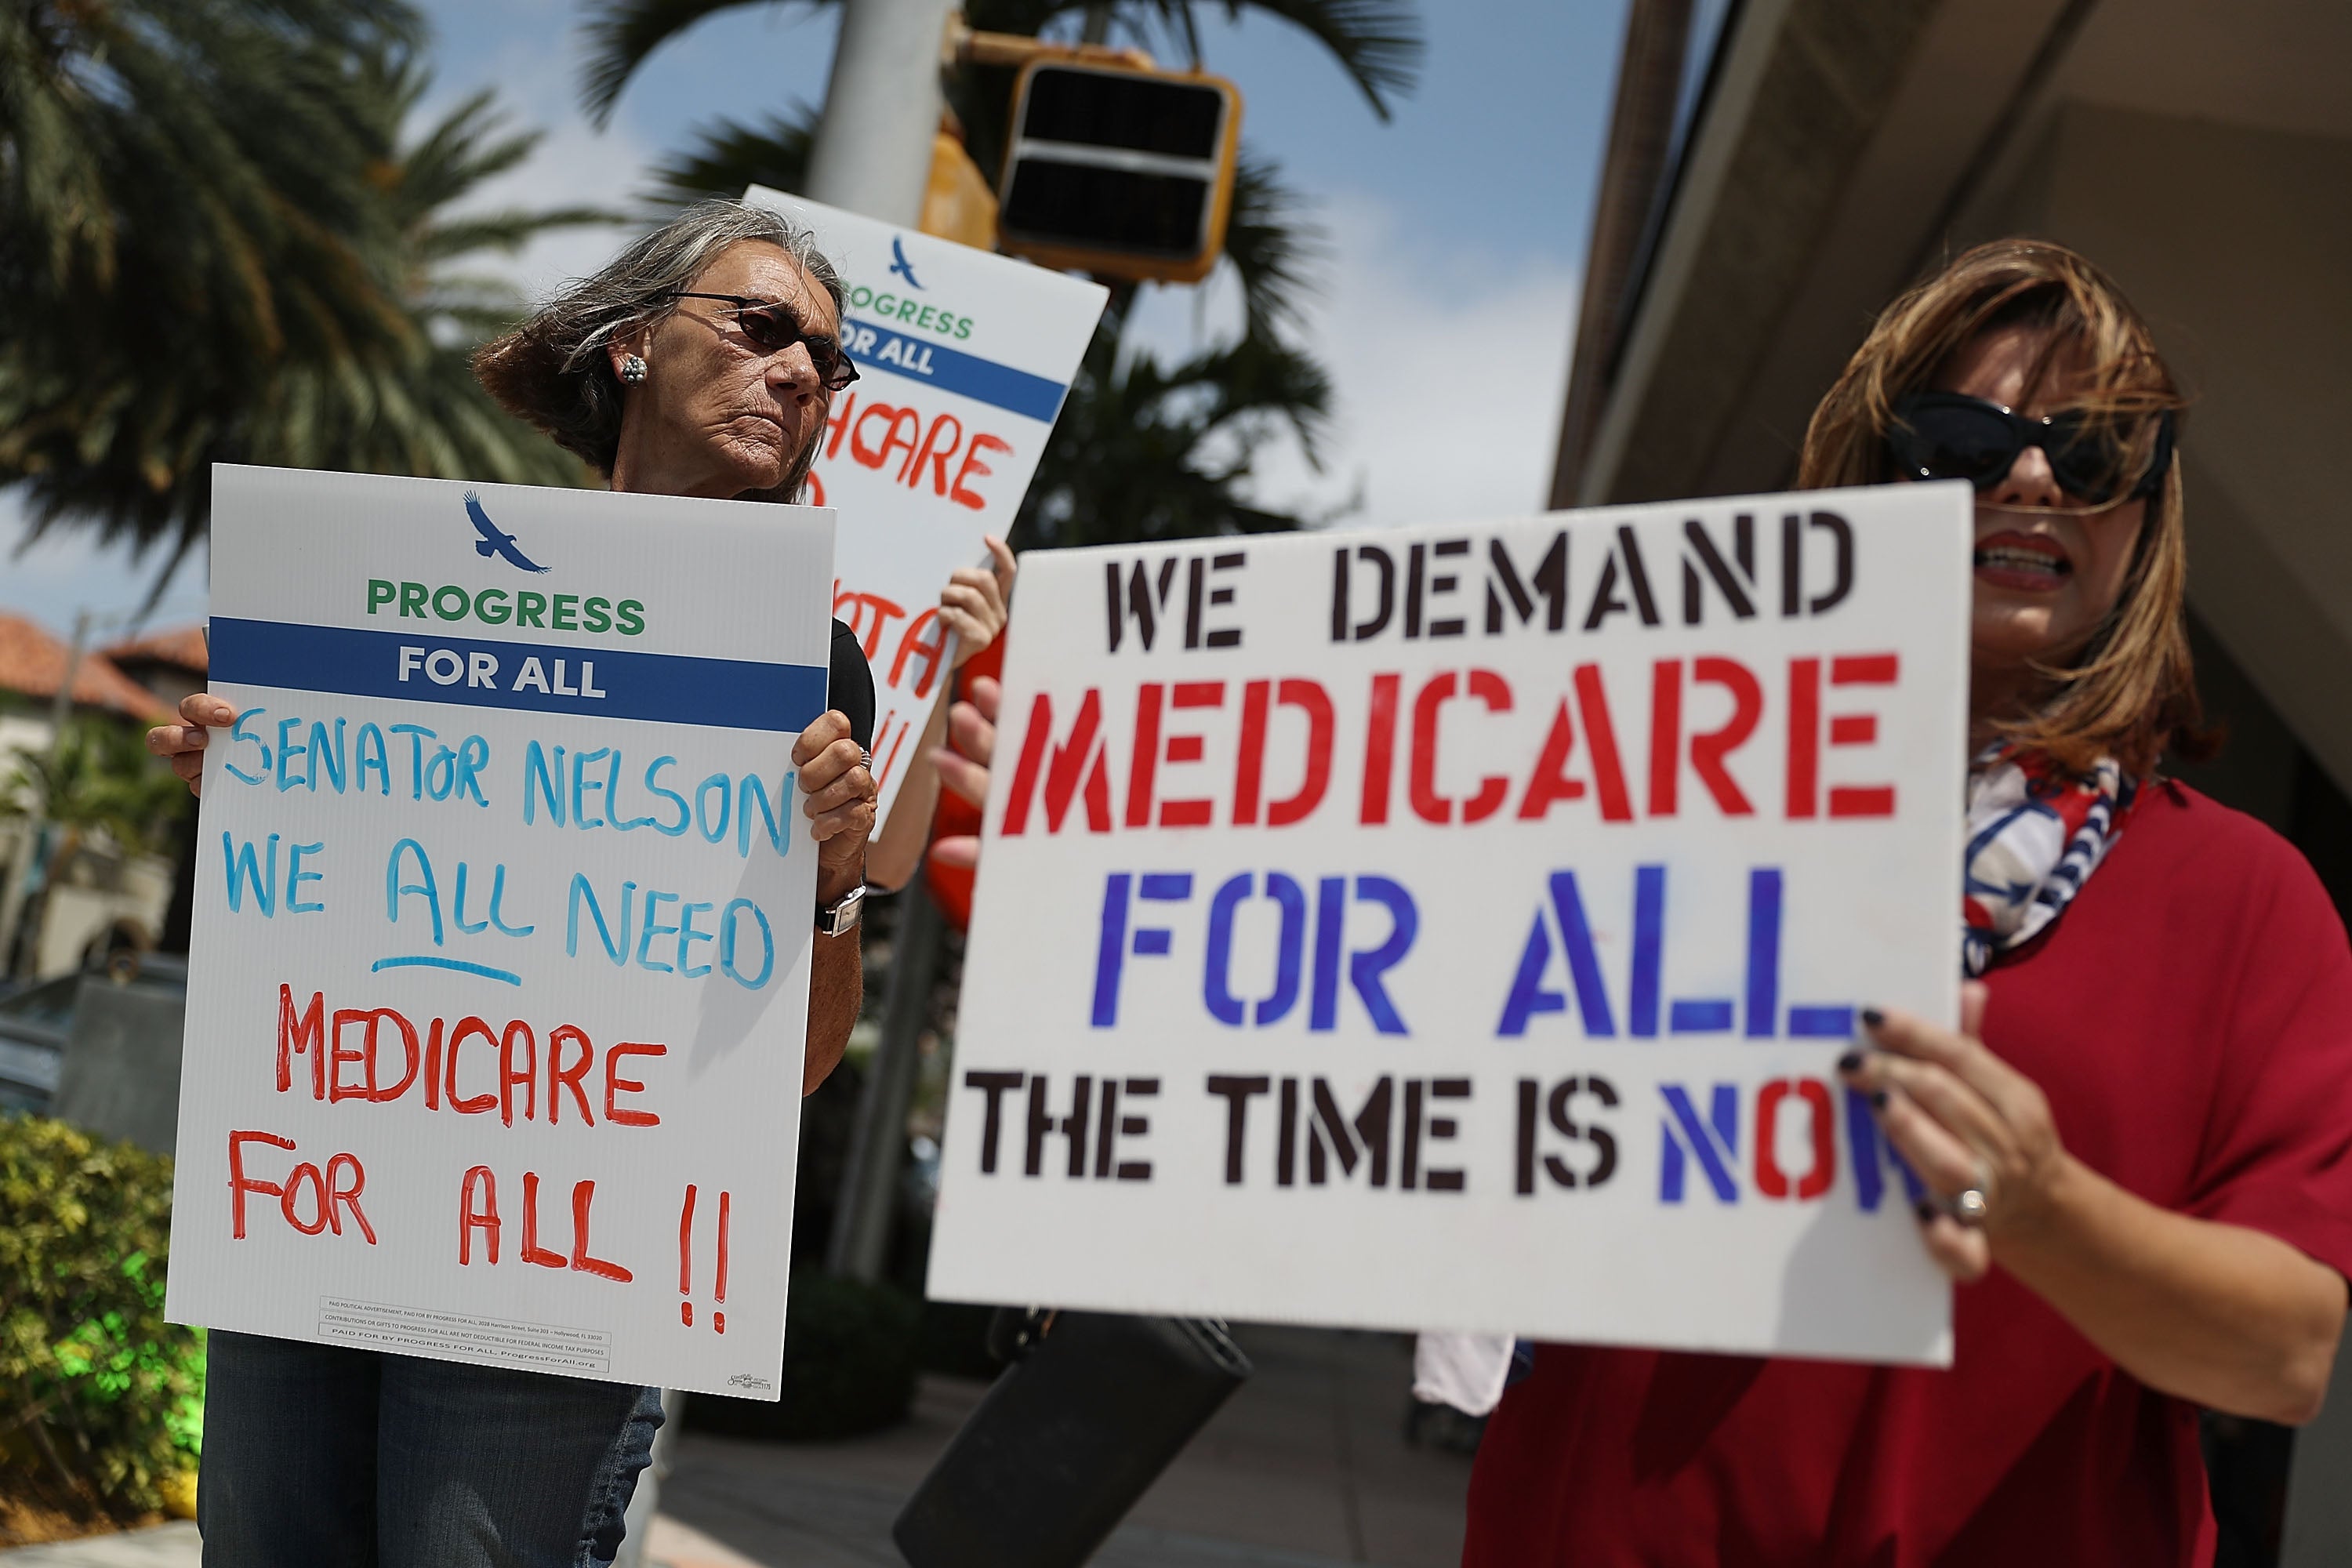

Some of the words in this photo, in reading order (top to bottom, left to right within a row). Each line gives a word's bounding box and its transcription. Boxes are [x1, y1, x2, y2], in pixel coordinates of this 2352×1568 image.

[839, 280, 975, 340] OGRESS
[840, 321, 879, 356] OR
[877, 336, 935, 376] ALL
[368, 579, 645, 636] PROGRESS
[1105, 553, 1246, 653] WE
[1330, 510, 1856, 643] DEMAND
[398, 646, 496, 689] FOR
[512, 657, 606, 699] ALL
[224, 707, 489, 808] SENATOR
[524, 739, 795, 858] NELSON
[1000, 654, 1900, 837] MEDICARE
[223, 831, 325, 918] WE
[387, 838, 535, 946] ALL
[566, 873, 775, 990] NEED
[1091, 872, 1420, 1036] FOR
[1496, 864, 1857, 1040] ALL
[276, 983, 668, 1128] MEDICARE
[964, 1070, 1161, 1181] THE
[1206, 1074, 1473, 1192] TIME
[1515, 1075, 1621, 1197] IS
[228, 1131, 377, 1245] FOR
[459, 1165, 633, 1283] ALL
[325, 1314, 367, 1324] CONTRIBUTIONS
[474, 1334, 505, 1343] DEDUCTIBLE
[576, 1347, 604, 1356] PURPOSES
[397, 1337, 451, 1348] PROGRESS
[453, 1344, 474, 1352] FOR
[501, 1350, 596, 1368] ProgressForAll.org
